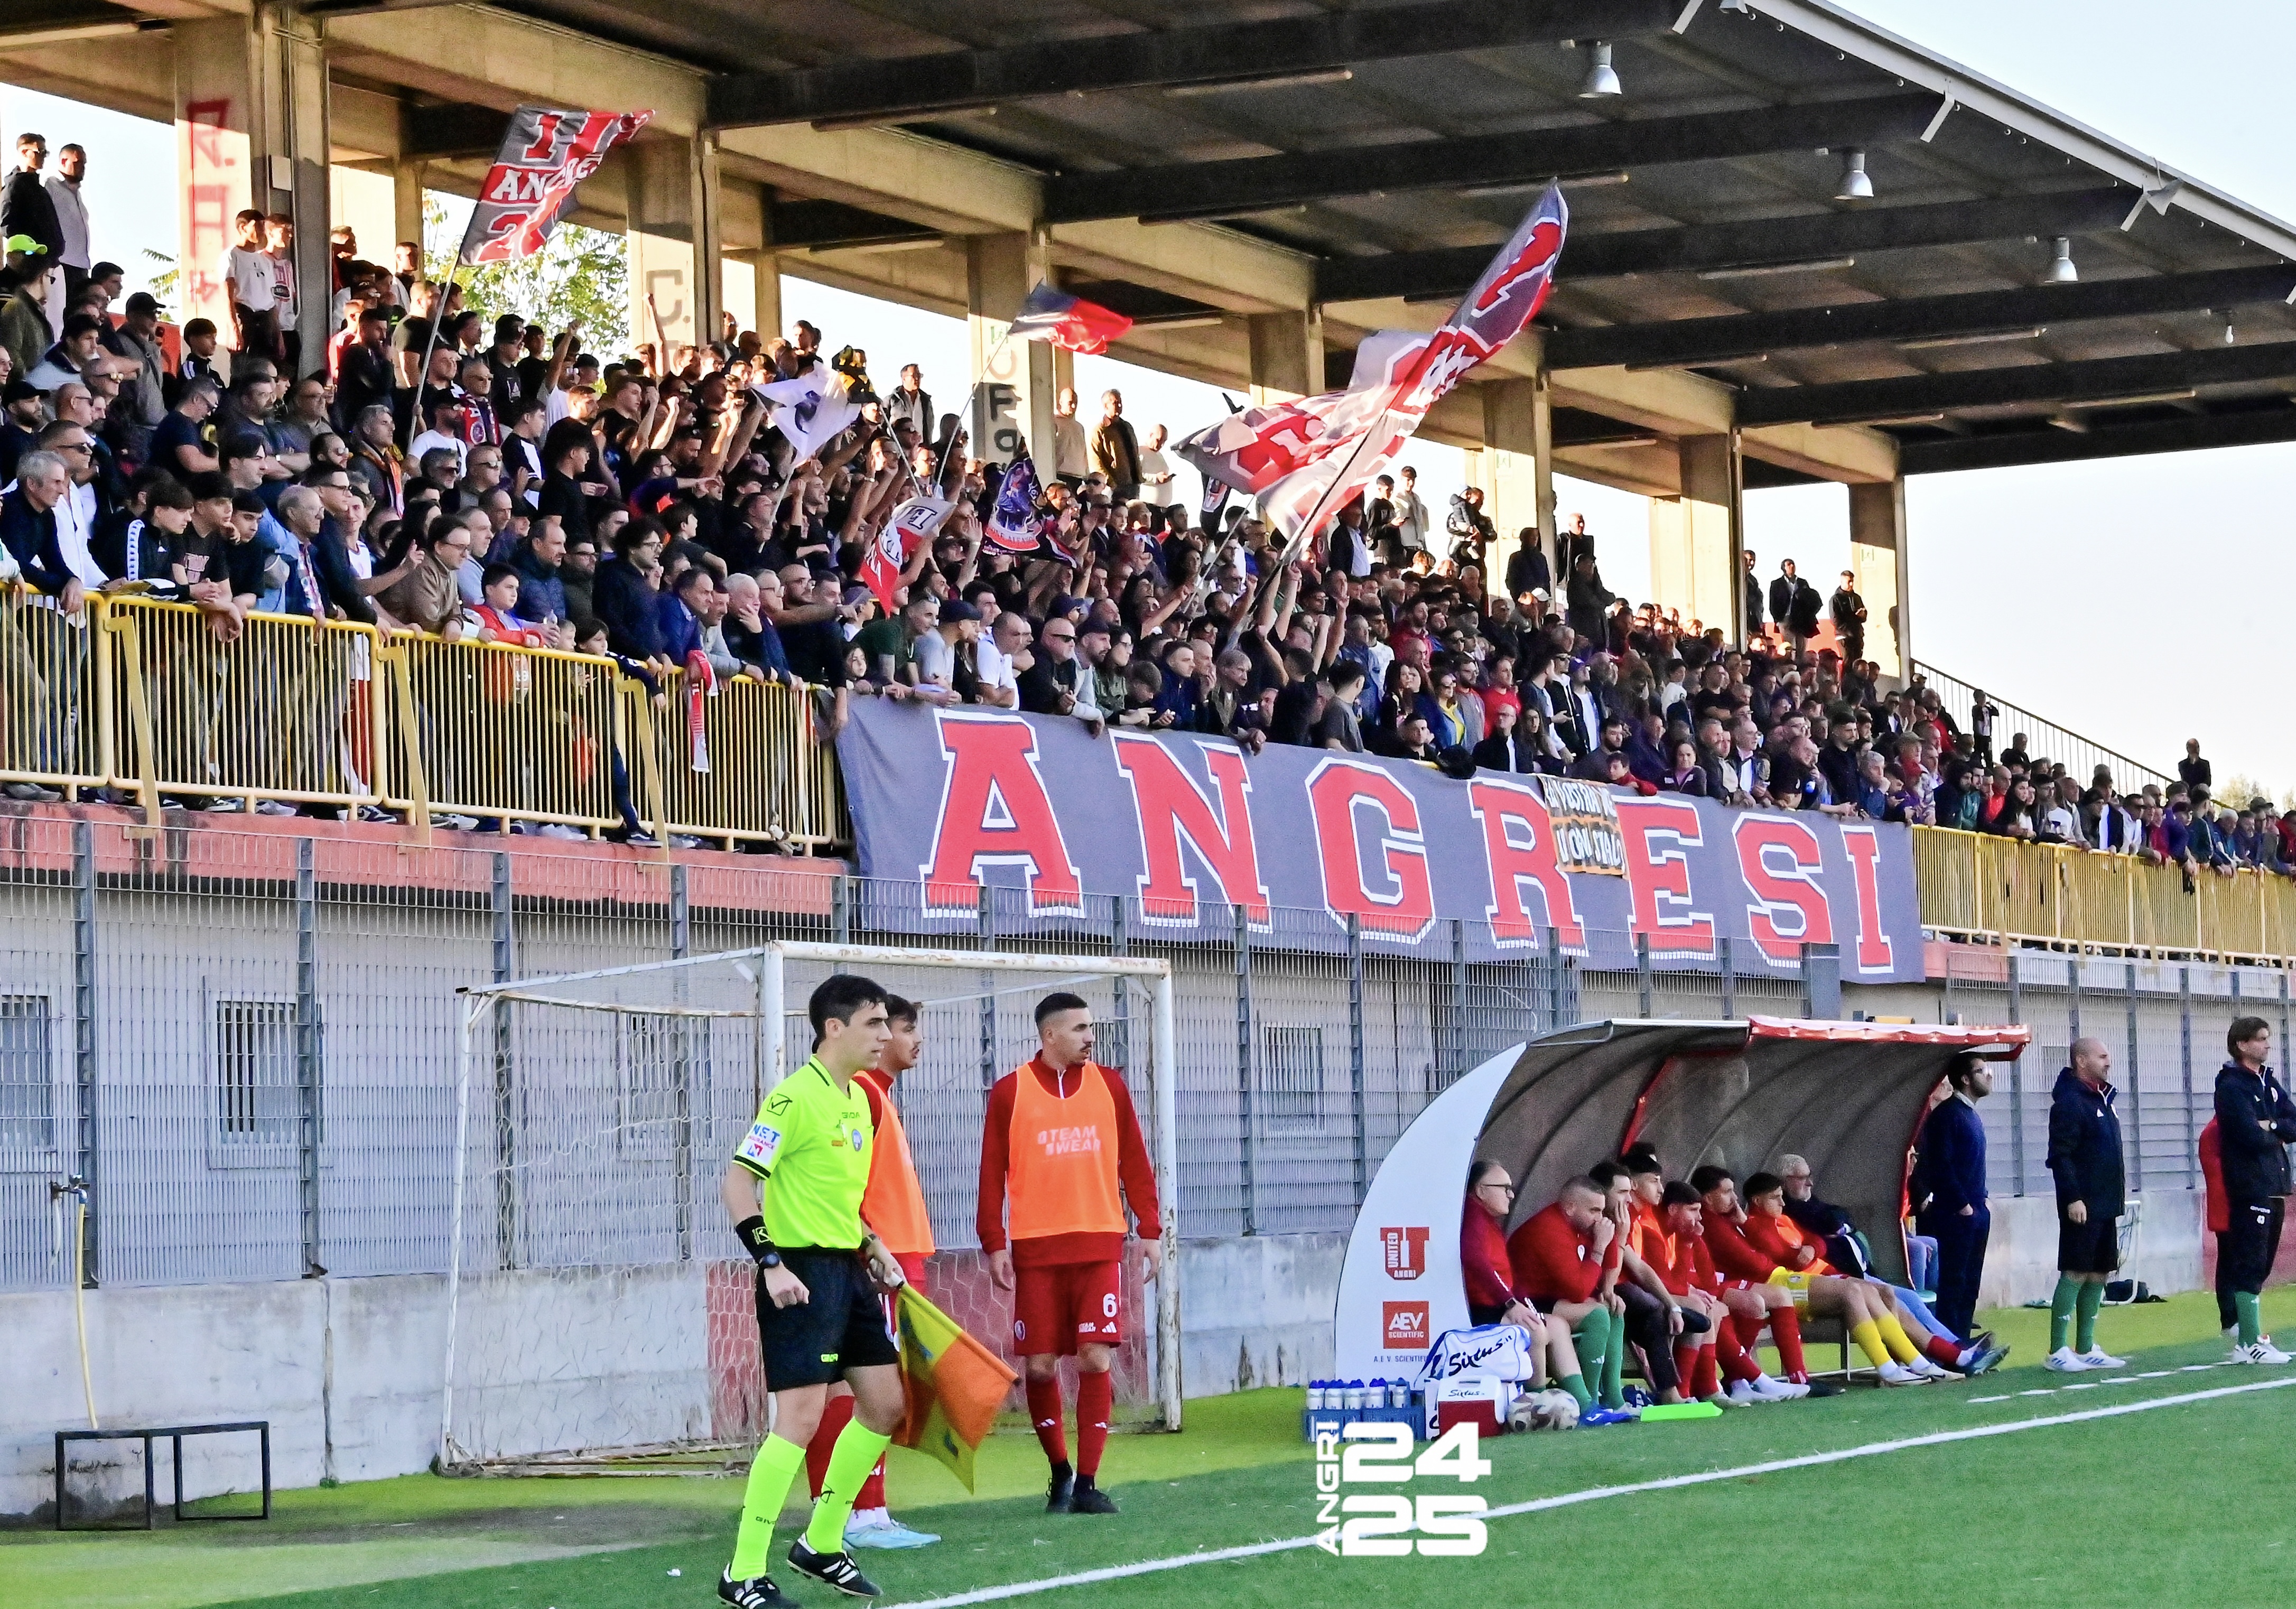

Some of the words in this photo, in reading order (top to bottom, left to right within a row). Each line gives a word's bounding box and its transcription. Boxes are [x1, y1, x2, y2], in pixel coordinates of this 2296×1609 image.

[918, 708, 1895, 974] ANGRESI
[754, 1124, 780, 1142] NET
[1387, 1232, 1399, 1268] UNITED
[1103, 1293, 1117, 1317] 6
[1389, 1313, 1424, 1331] AEV
